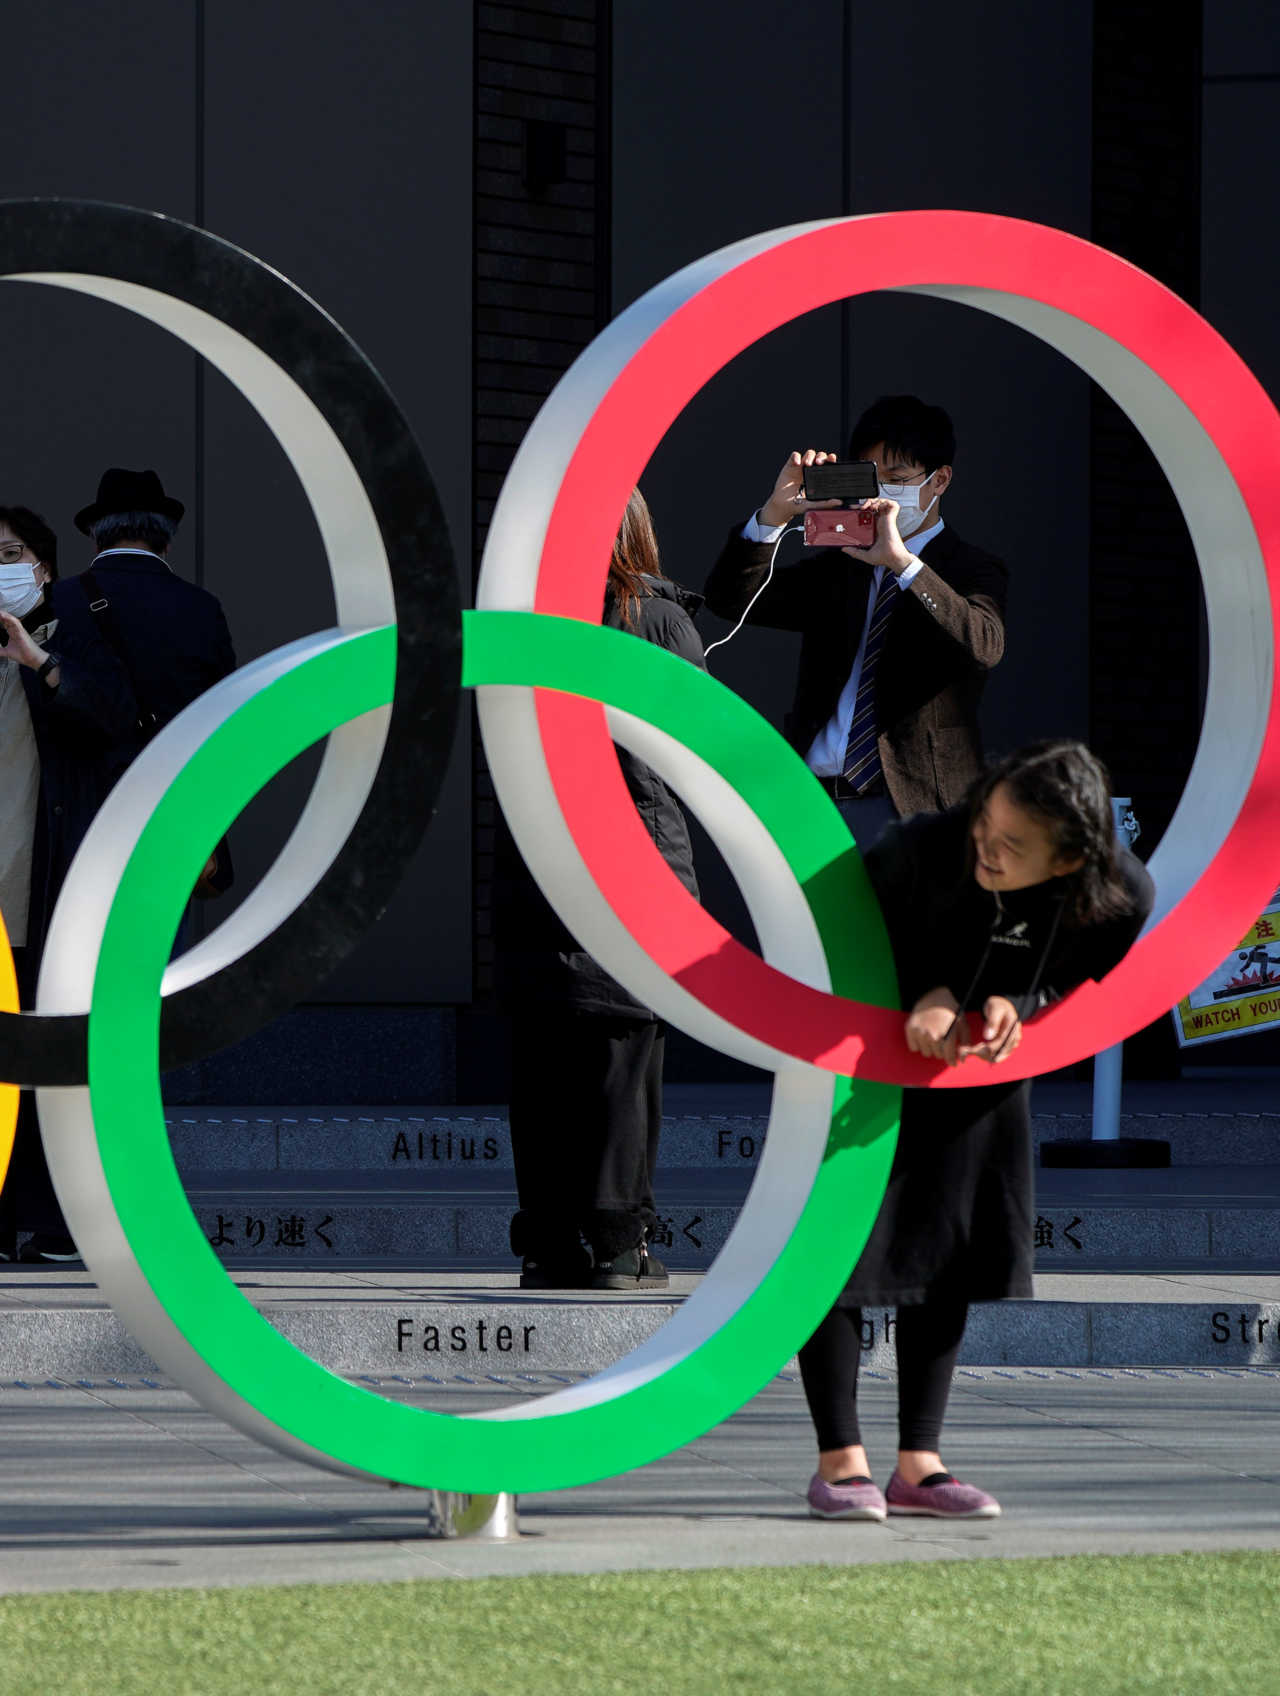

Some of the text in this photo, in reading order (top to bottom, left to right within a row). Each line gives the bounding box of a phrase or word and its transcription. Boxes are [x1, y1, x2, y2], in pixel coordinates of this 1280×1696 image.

[1191, 998, 1280, 1029] WATCH YOU
[392, 1131, 498, 1160] Altius
[718, 1130, 765, 1158] Fo
[209, 1214, 333, 1248] より速く
[397, 1319, 537, 1352] Faster
[1211, 1311, 1280, 1344] Str
